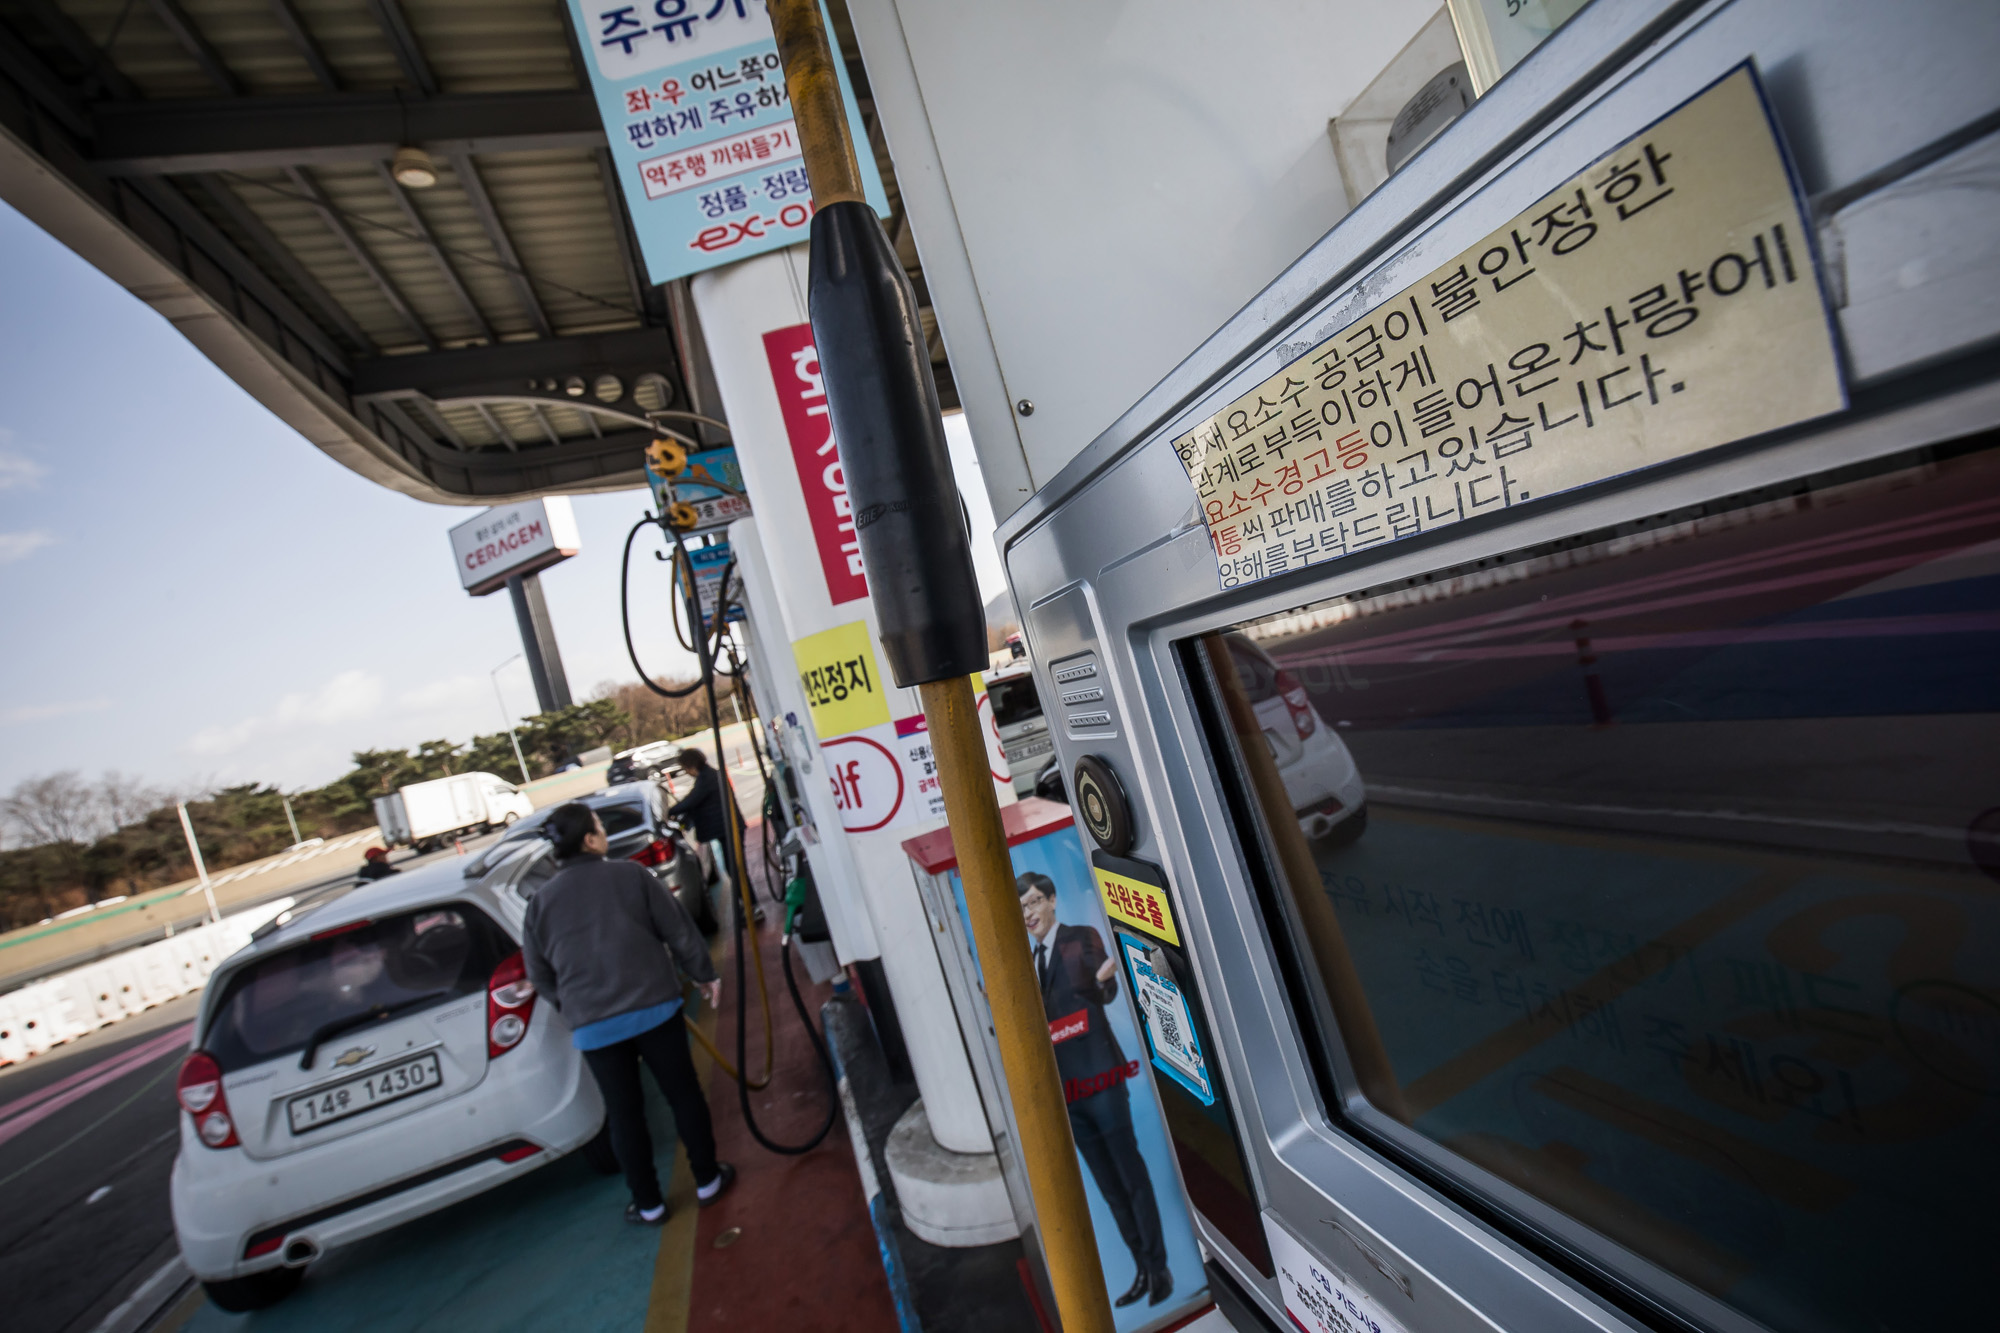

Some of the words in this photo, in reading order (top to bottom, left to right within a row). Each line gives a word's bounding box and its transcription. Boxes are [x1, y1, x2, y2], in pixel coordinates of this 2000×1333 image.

[627, 107, 703, 149] 편하게
[709, 82, 789, 124] 주유하
[645, 154, 706, 186] 역주행
[710, 129, 792, 165] 끼워들기
[700, 185, 748, 218] 정품
[1179, 422, 1228, 469] 현재
[1228, 377, 1309, 441] 요소수
[1312, 297, 1428, 390] 공급이
[1431, 143, 1674, 323] 불안정한
[464, 519, 545, 571] CERAGEM
[1104, 881, 1166, 931] 직원호출
[1384, 884, 1445, 936] 시작
[1452, 898, 1534, 961] 전에
[363, 1063, 425, 1101] 1430
